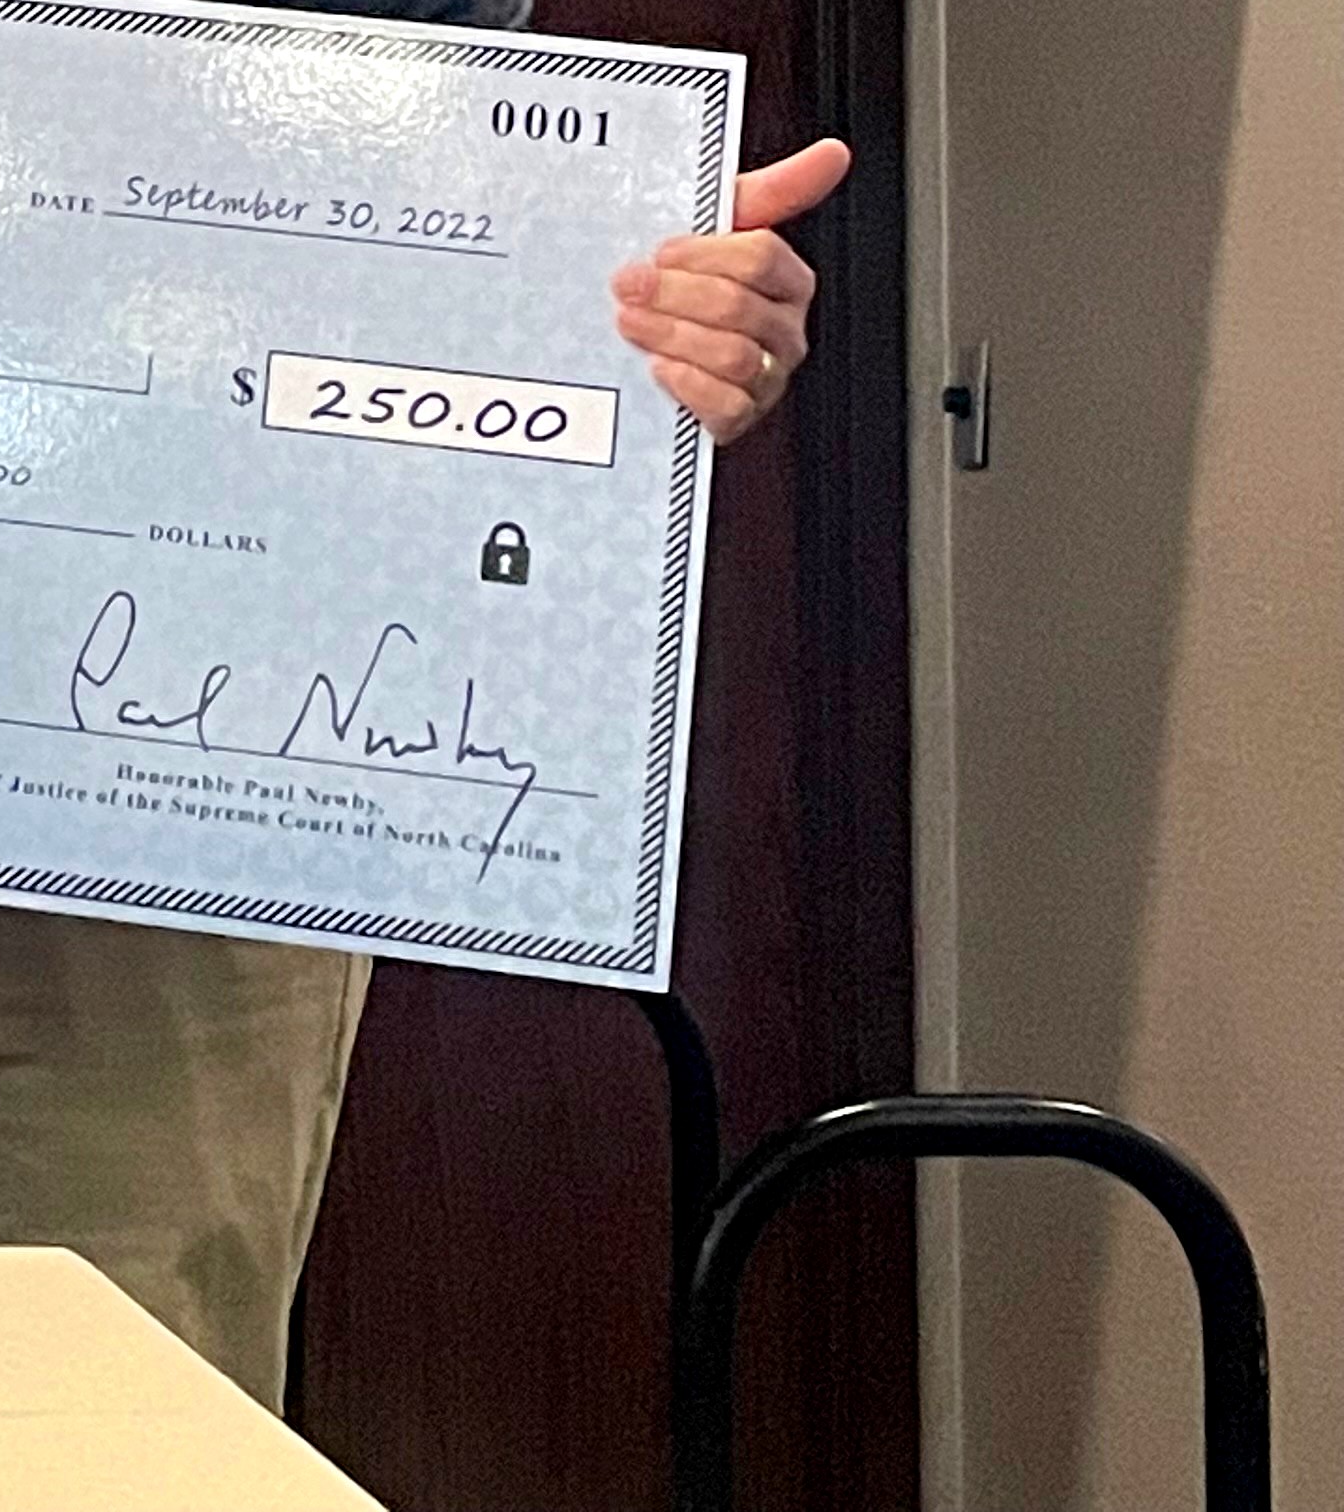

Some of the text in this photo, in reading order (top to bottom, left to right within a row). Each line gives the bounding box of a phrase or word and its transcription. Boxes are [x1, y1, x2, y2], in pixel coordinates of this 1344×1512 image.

[490, 99, 614, 149] 0001
[30, 174, 496, 243] DATE September 30, 2022
[229, 366, 569, 443] $ 250.00
[148, 523, 269, 554] DOLLARS
[70, 590, 233, 754] Paul
[116, 761, 236, 795] Honorable
[244, 778, 294, 803] Paul
[8, 774, 88, 802] Justice
[95, 787, 120, 806] of
[126, 791, 162, 812] the
[168, 797, 271, 825] Supreme
[277, 809, 344, 835] Court
[352, 822, 377, 839] of
[383, 824, 451, 850] North
[459, 834, 562, 864] Carolina
